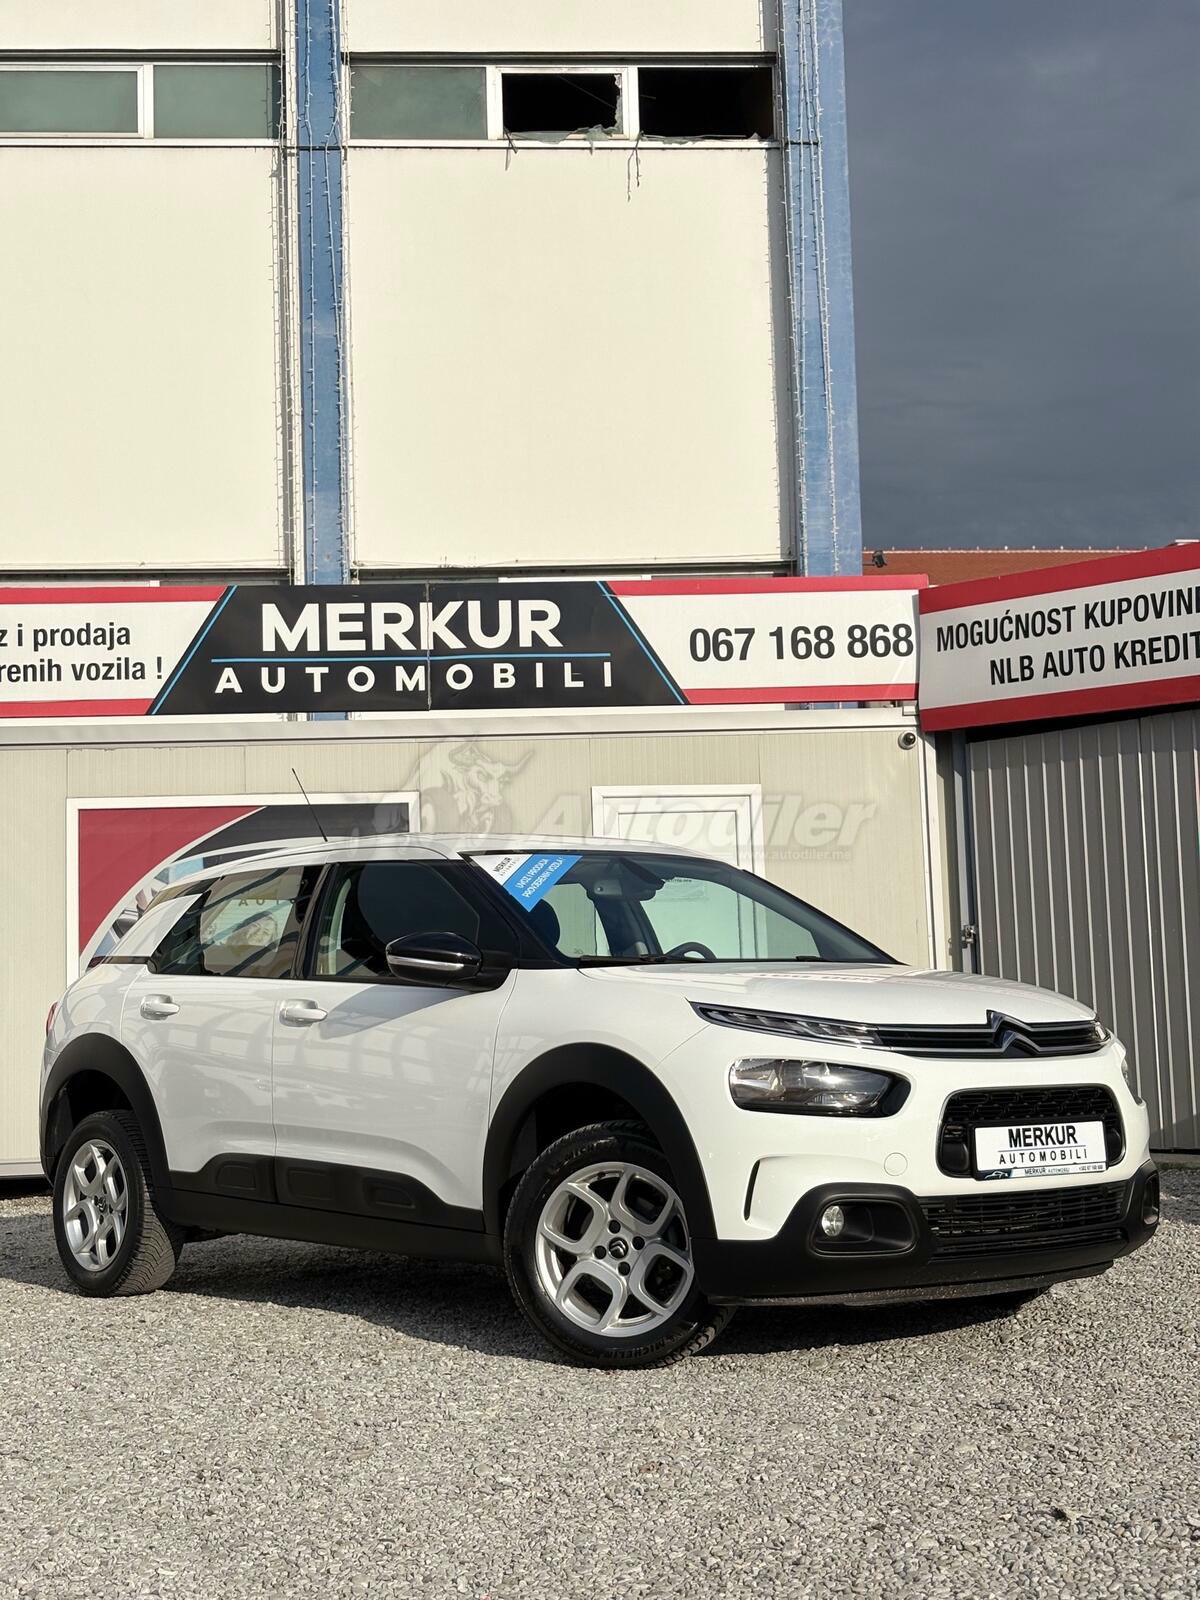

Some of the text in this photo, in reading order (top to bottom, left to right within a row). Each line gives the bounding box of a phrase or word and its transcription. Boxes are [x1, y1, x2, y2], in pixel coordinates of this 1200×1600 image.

[17, 623, 23, 647] i
[33, 622, 131, 651] prodaja
[262, 600, 563, 652] MERKUR
[936, 605, 1076, 652] MOGUĆNOST
[689, 623, 914, 662] 067 168 868
[71, 658, 146, 682] vozila
[215, 662, 612, 694] AUTOMOBILI
[990, 655, 1034, 685] NLB
[1042, 644, 1105, 679] AUTO
[1008, 1125, 1078, 1148] MERKUR
[999, 1148, 1087, 1164] AUTOMOBILI
